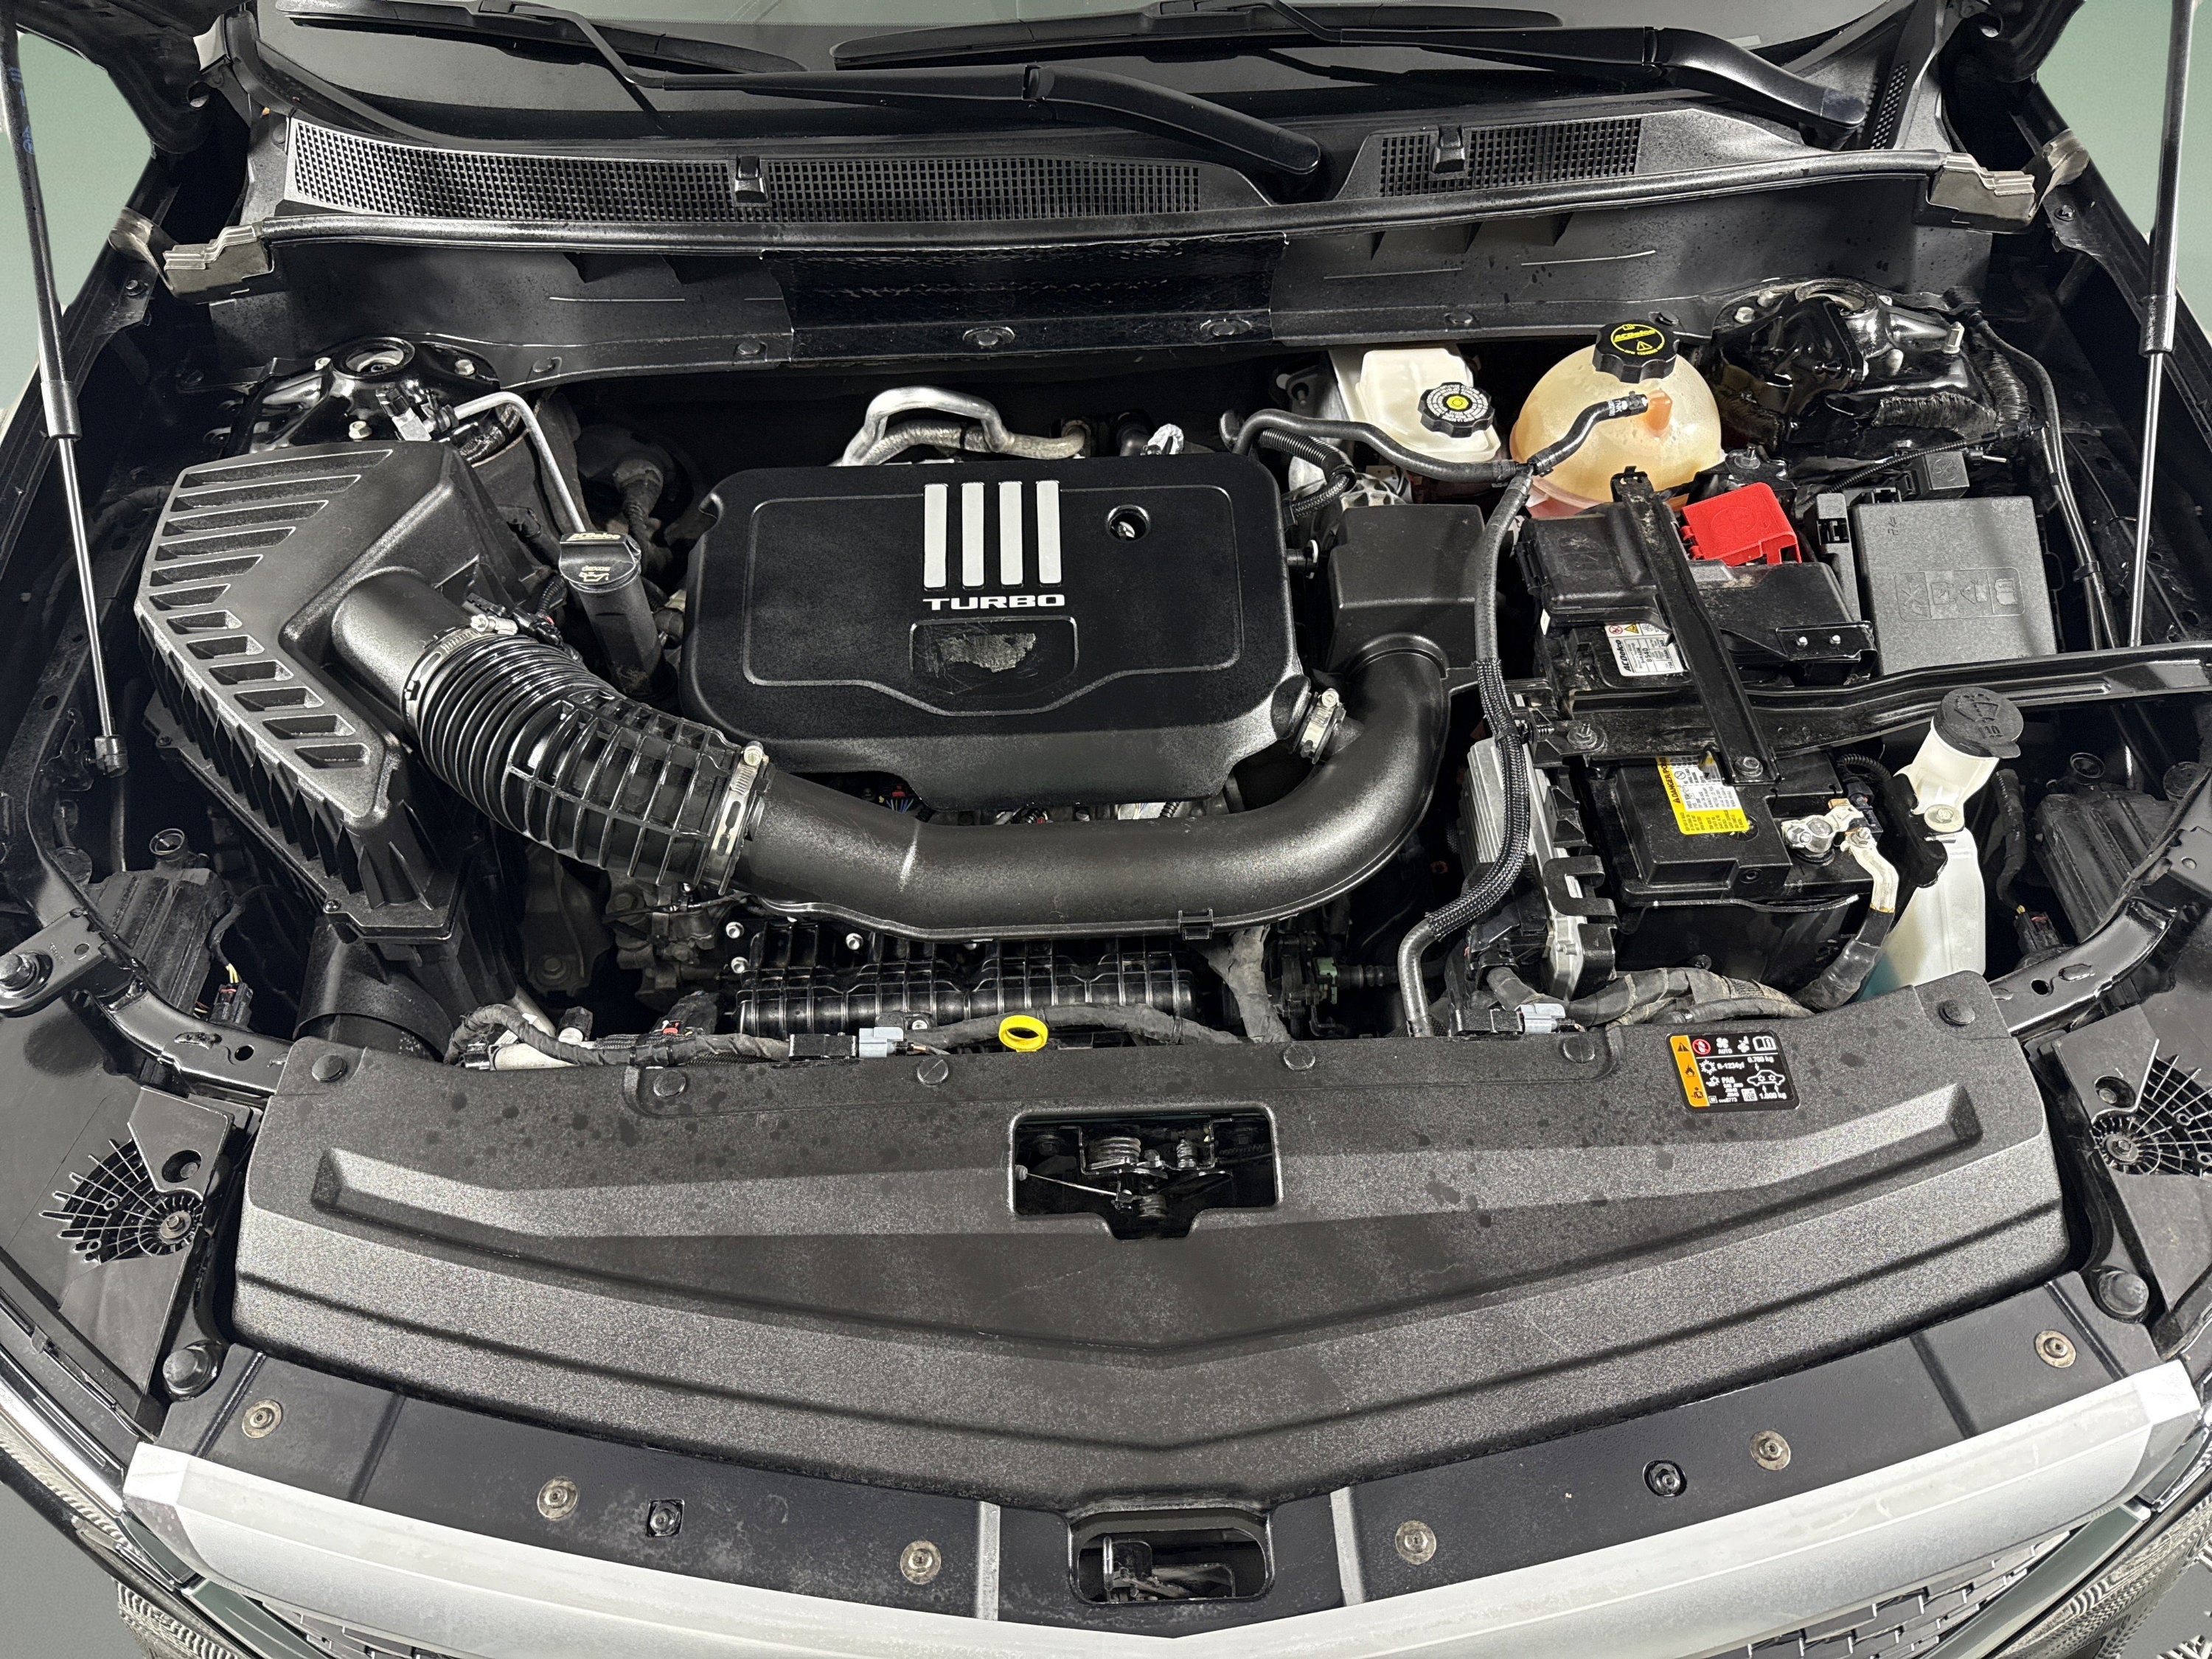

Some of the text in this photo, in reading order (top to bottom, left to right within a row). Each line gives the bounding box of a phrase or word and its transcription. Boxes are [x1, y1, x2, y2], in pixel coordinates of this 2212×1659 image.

[922, 594, 1065, 611] TURBO
[1615, 639, 1632, 672] ACDelco
[1717, 1062, 1745, 1071] R-1234yf
[1777, 1091, 1787, 1099] kg
